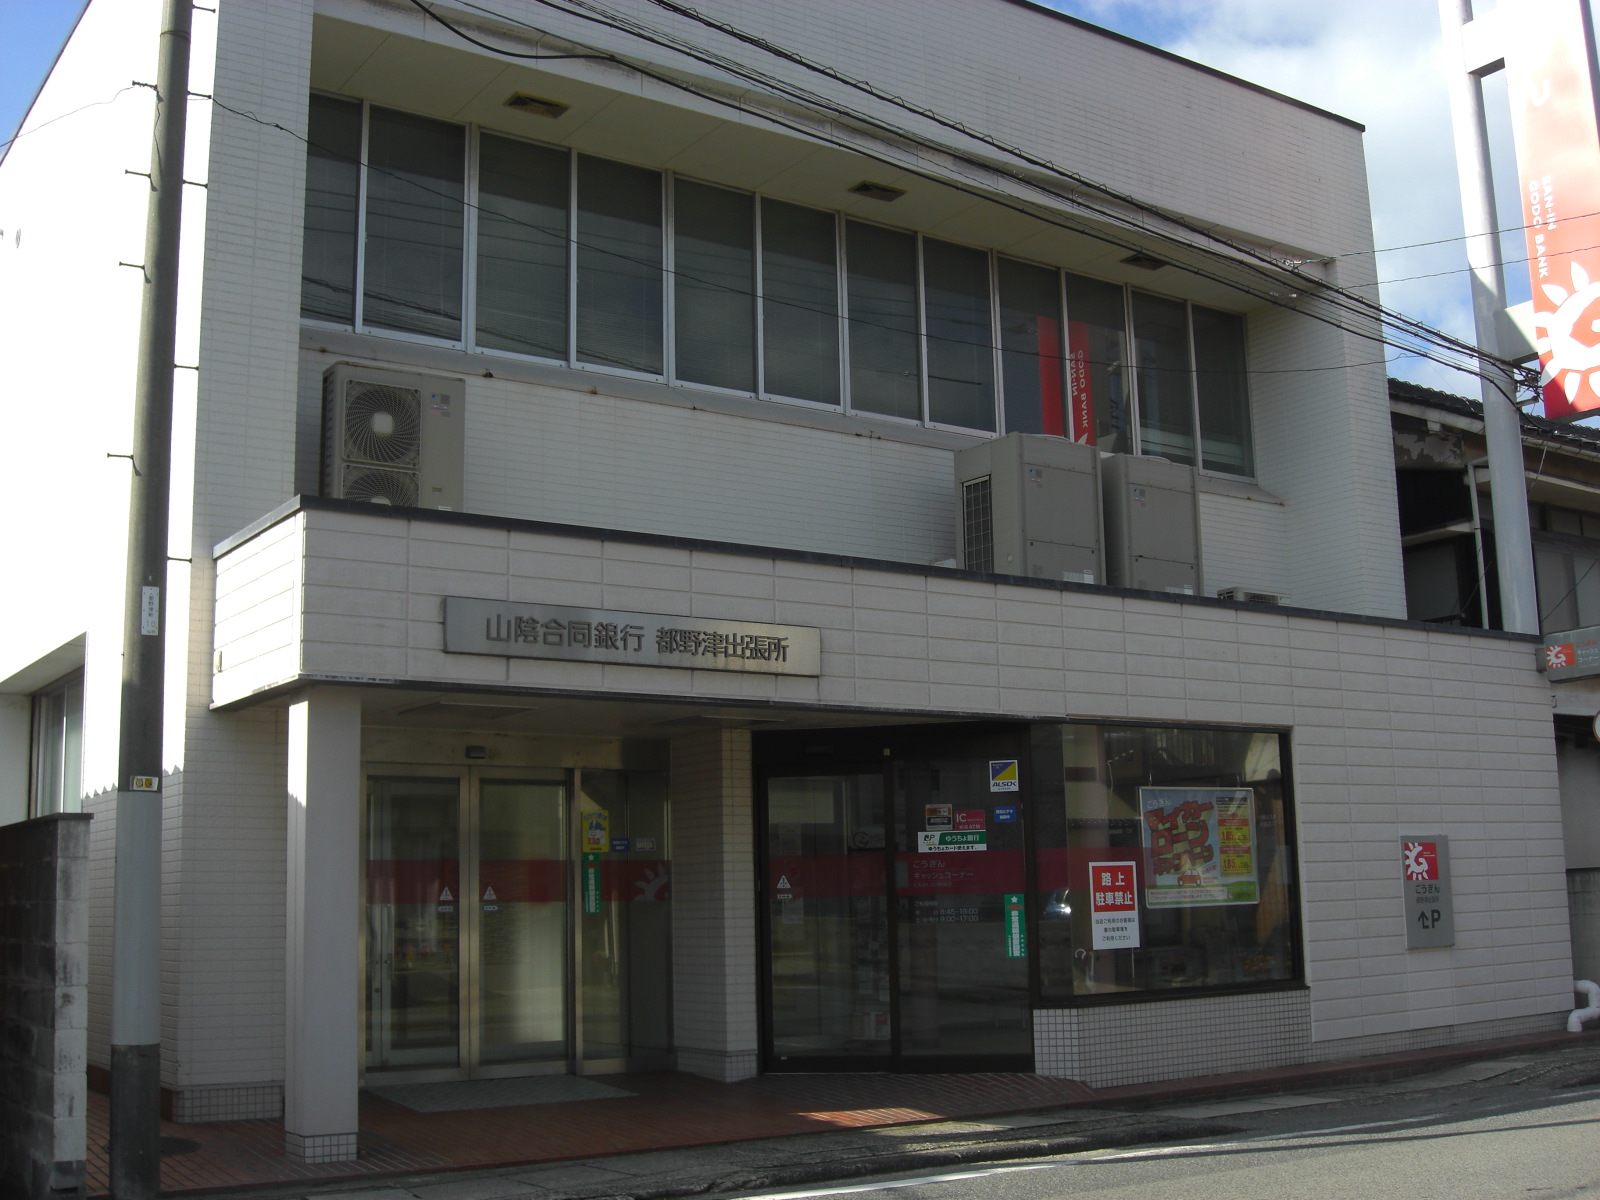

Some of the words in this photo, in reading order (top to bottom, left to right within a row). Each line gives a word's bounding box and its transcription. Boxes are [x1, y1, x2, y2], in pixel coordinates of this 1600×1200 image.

[1534, 234, 1549, 279] BANK
[486, 613, 646, 653] 山陰合同銀行
[655, 626, 791, 663] 都野津出張所
[956, 813, 967, 823] IC
[1144, 800, 1215, 831] マイカー
[945, 833, 980, 842] ゆうちょ銀行
[1151, 820, 1210, 858] ローン
[913, 871, 974, 880] キャッシュコーナー
[1101, 871, 1125, 886] 路上
[1416, 884, 1440, 894] ごうぎん
[1095, 891, 1133, 906] 駐車禁止
[1431, 909, 1441, 929] P
